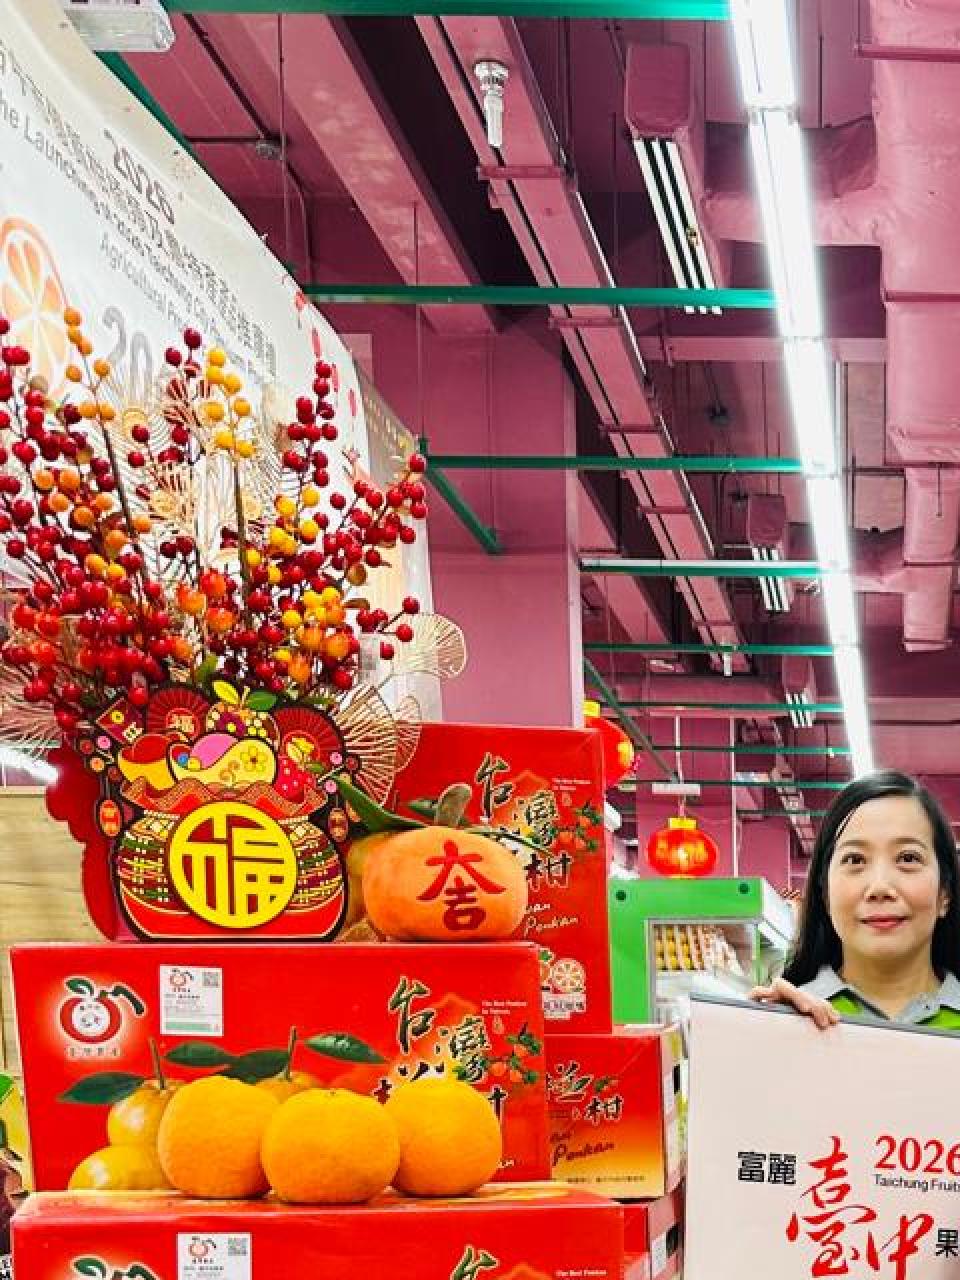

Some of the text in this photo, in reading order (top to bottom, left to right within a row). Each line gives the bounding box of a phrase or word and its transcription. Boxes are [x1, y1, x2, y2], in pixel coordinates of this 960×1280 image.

[176, 807, 292, 922] 福
[418, 839, 507, 932] 大吉
[737, 1150, 797, 1185] 富麗
[871, 1173, 929, 1192] Taichung
